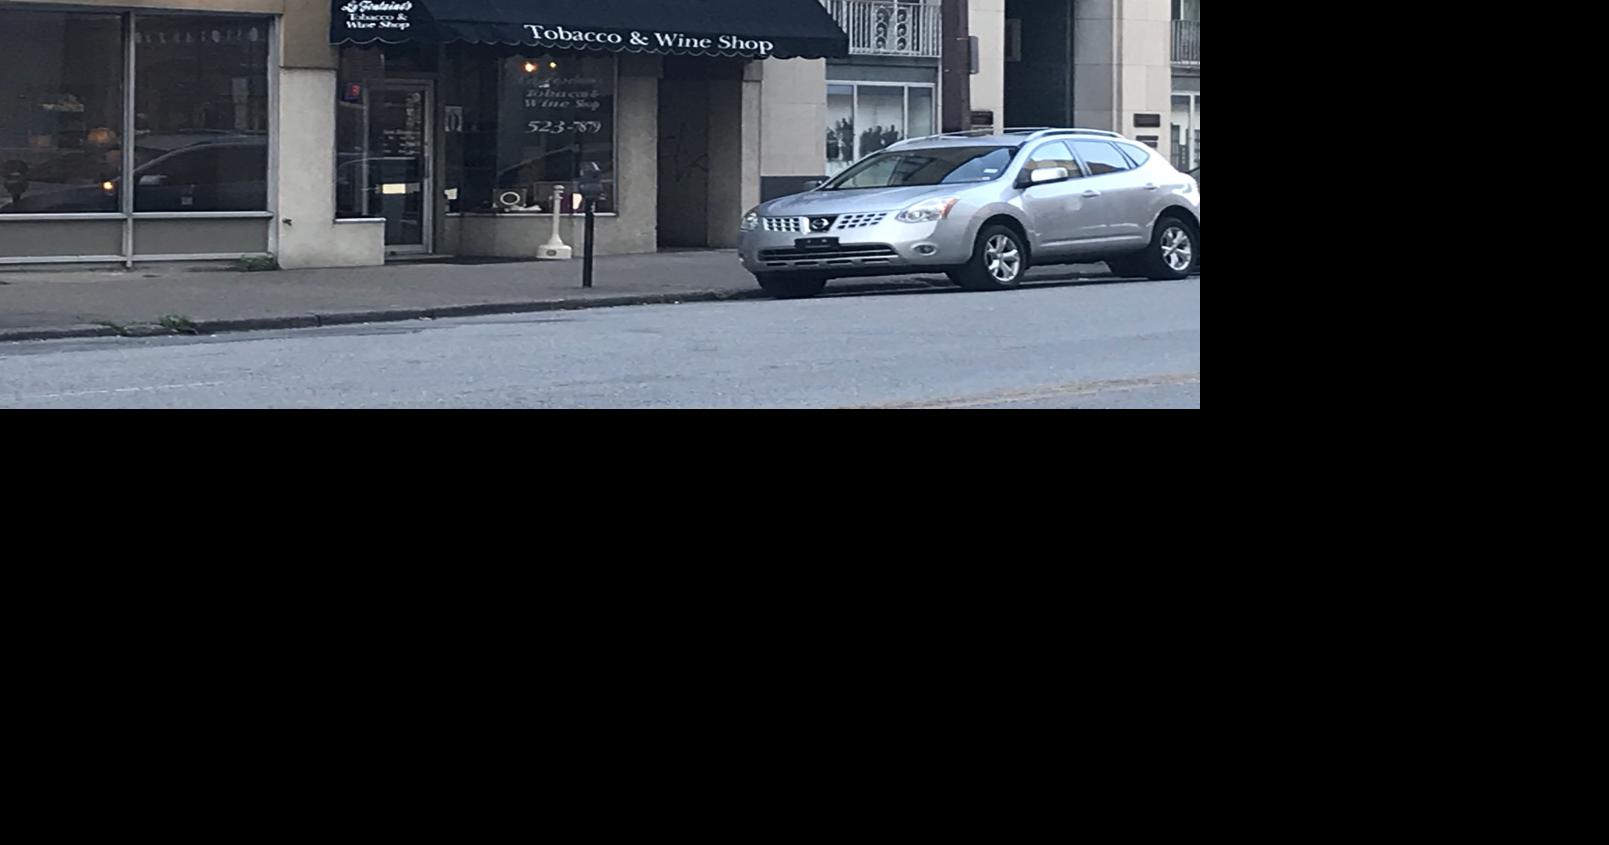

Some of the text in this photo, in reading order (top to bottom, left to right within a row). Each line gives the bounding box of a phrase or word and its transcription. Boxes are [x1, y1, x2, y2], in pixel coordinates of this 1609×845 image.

[348, 13, 408, 21] Tobacco &
[378, 21, 410, 30] Shop
[523, 24, 774, 55] Tobacco & Wine Shop
[525, 99, 600, 111] Wine Shop
